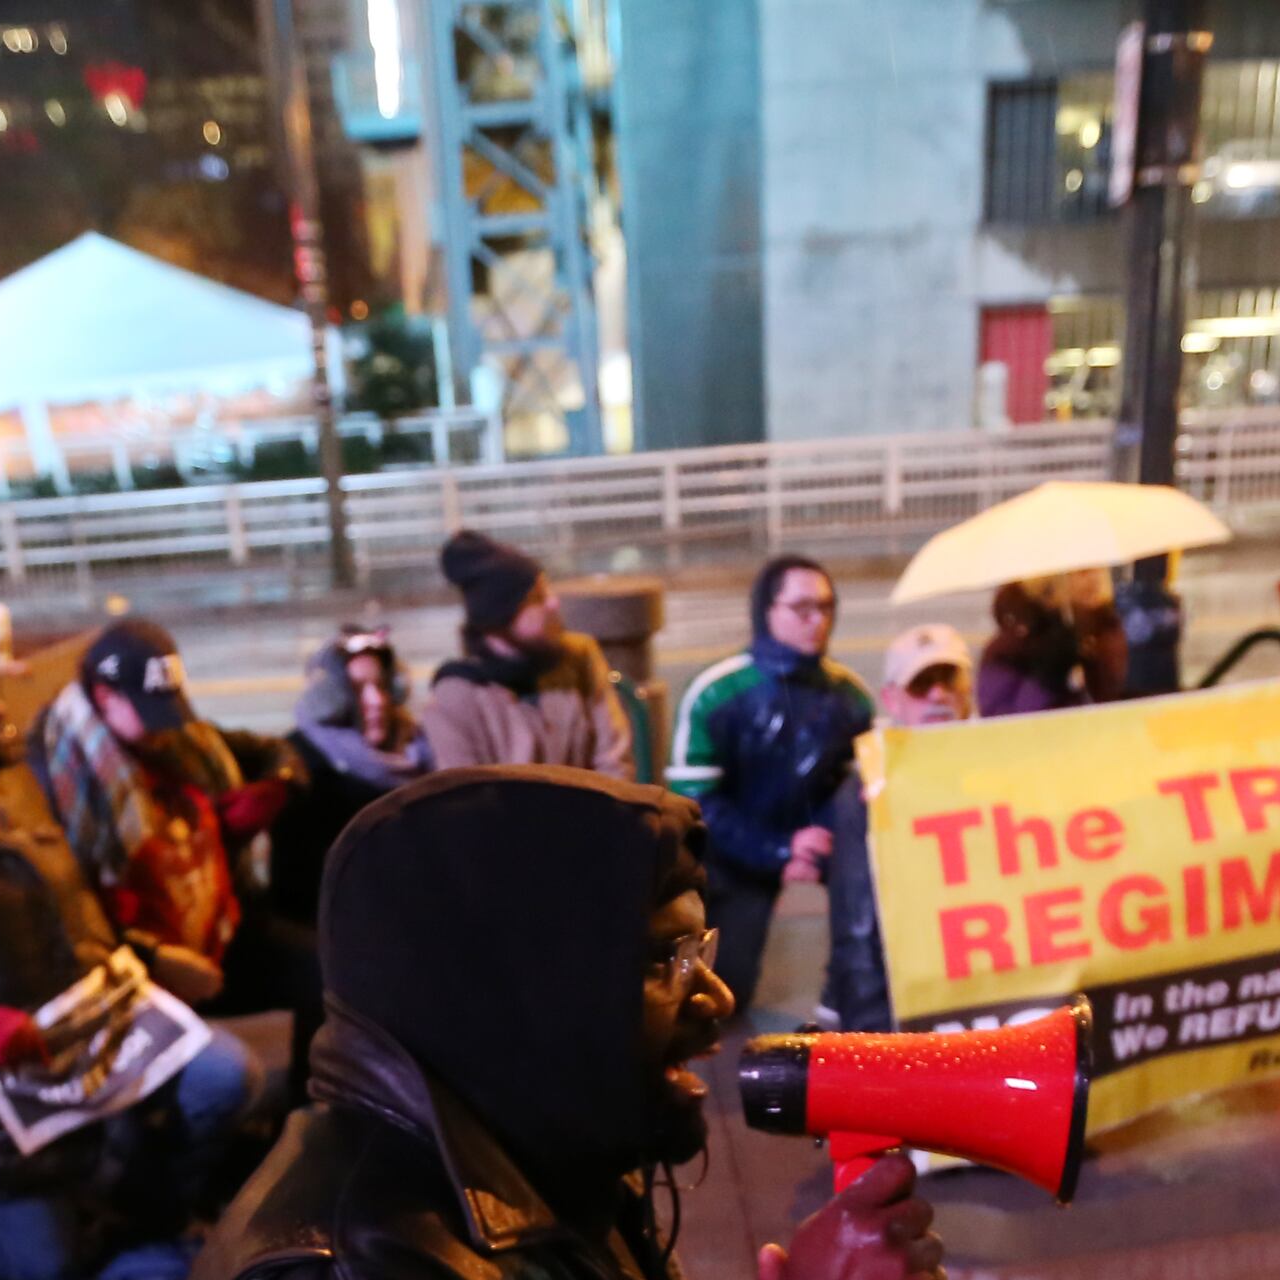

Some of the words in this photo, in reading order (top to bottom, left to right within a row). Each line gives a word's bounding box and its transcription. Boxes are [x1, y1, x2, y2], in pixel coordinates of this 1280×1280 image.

[911, 802, 1127, 886] The
[1112, 991, 1154, 1022] In
[1164, 980, 1230, 1013] the
[1110, 1020, 1168, 1061] We
